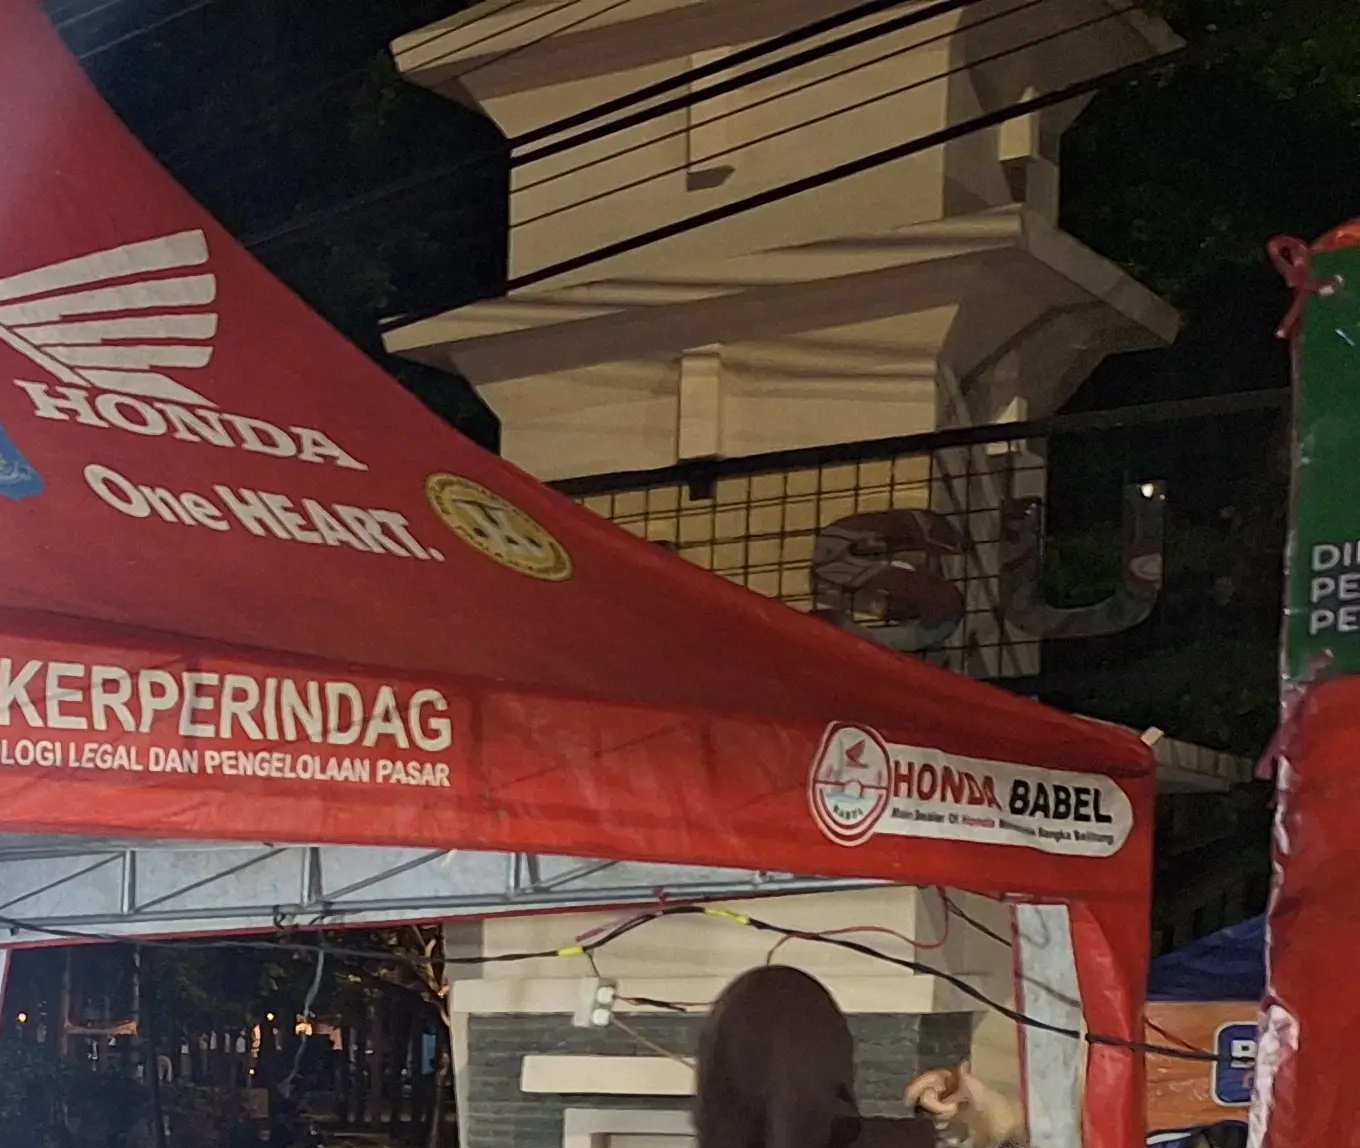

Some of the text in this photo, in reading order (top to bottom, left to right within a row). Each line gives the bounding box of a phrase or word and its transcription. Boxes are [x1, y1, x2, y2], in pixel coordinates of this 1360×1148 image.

[13, 378, 370, 472] HONDA
[83, 463, 231, 531] One
[212, 484, 446, 562] HEART.
[1311, 540, 1360, 572] DI
[68, 741, 144, 771] LEGAL
[148, 747, 198, 774] DAN
[204, 750, 370, 784] PENGELOLAAN
[376, 759, 451, 788] PASAR
[893, 760, 1113, 825] HONDA BABEL
